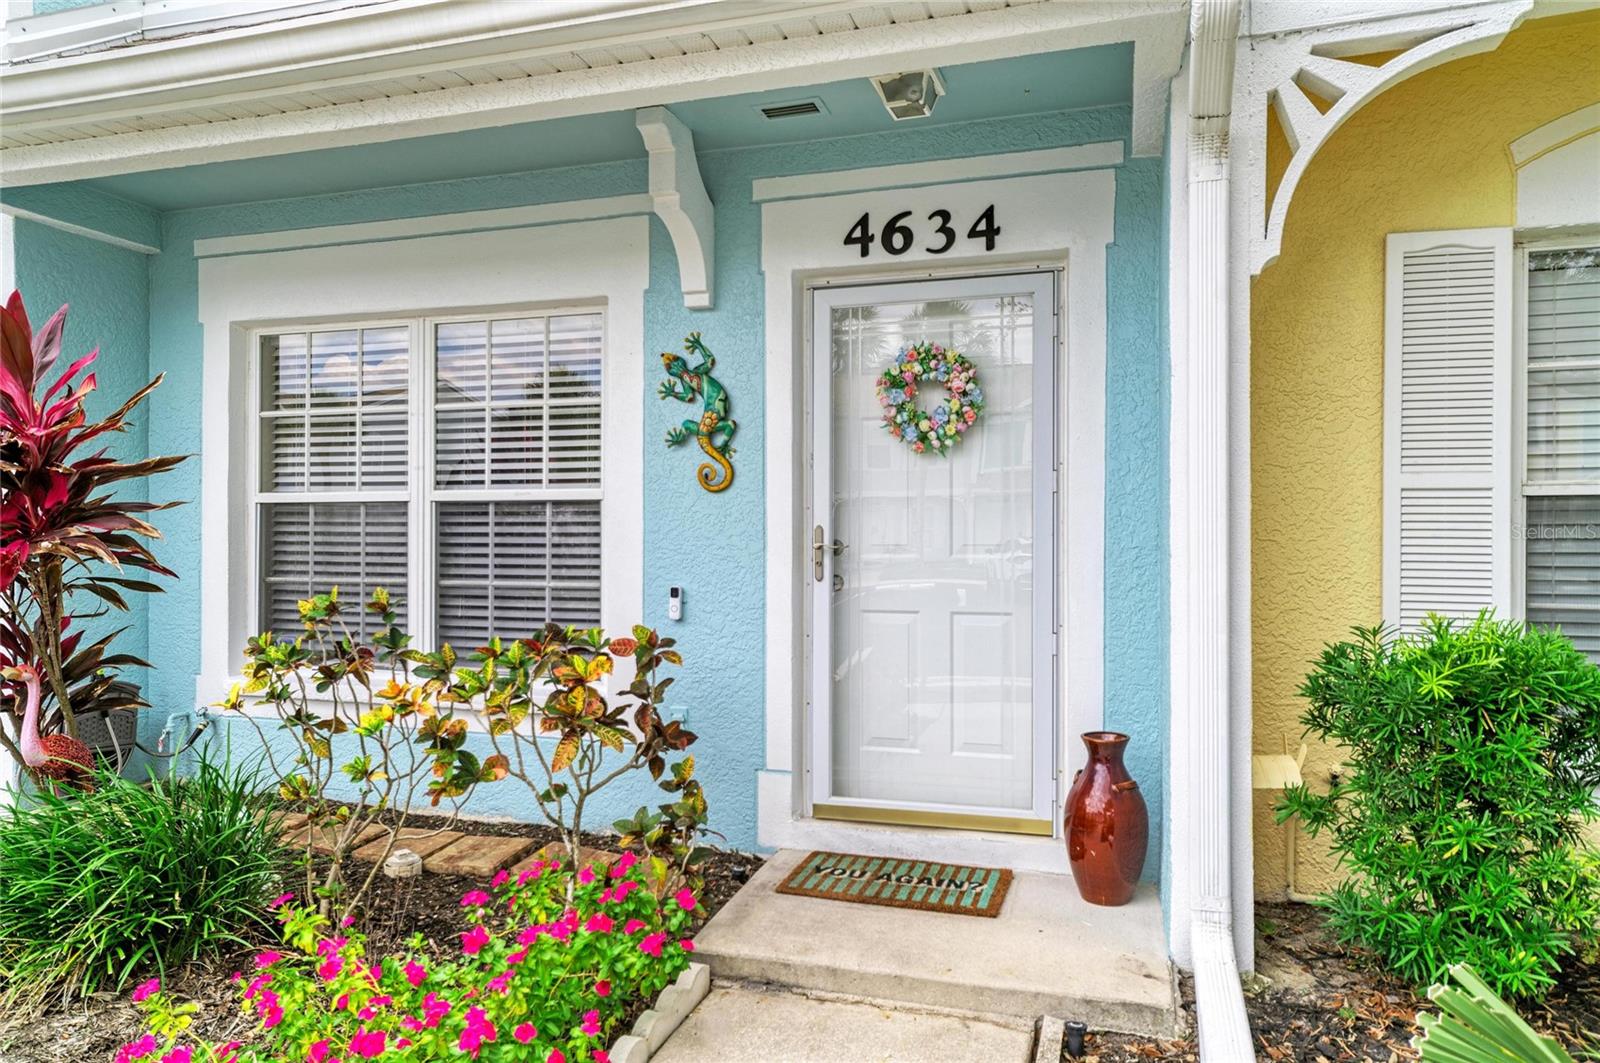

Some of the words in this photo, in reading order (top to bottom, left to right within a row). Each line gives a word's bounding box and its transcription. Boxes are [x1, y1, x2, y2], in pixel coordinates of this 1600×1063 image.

[843, 204, 1001, 258] 4634
[812, 864, 868, 881] YOU
[874, 871, 987, 893] AGAIN?
